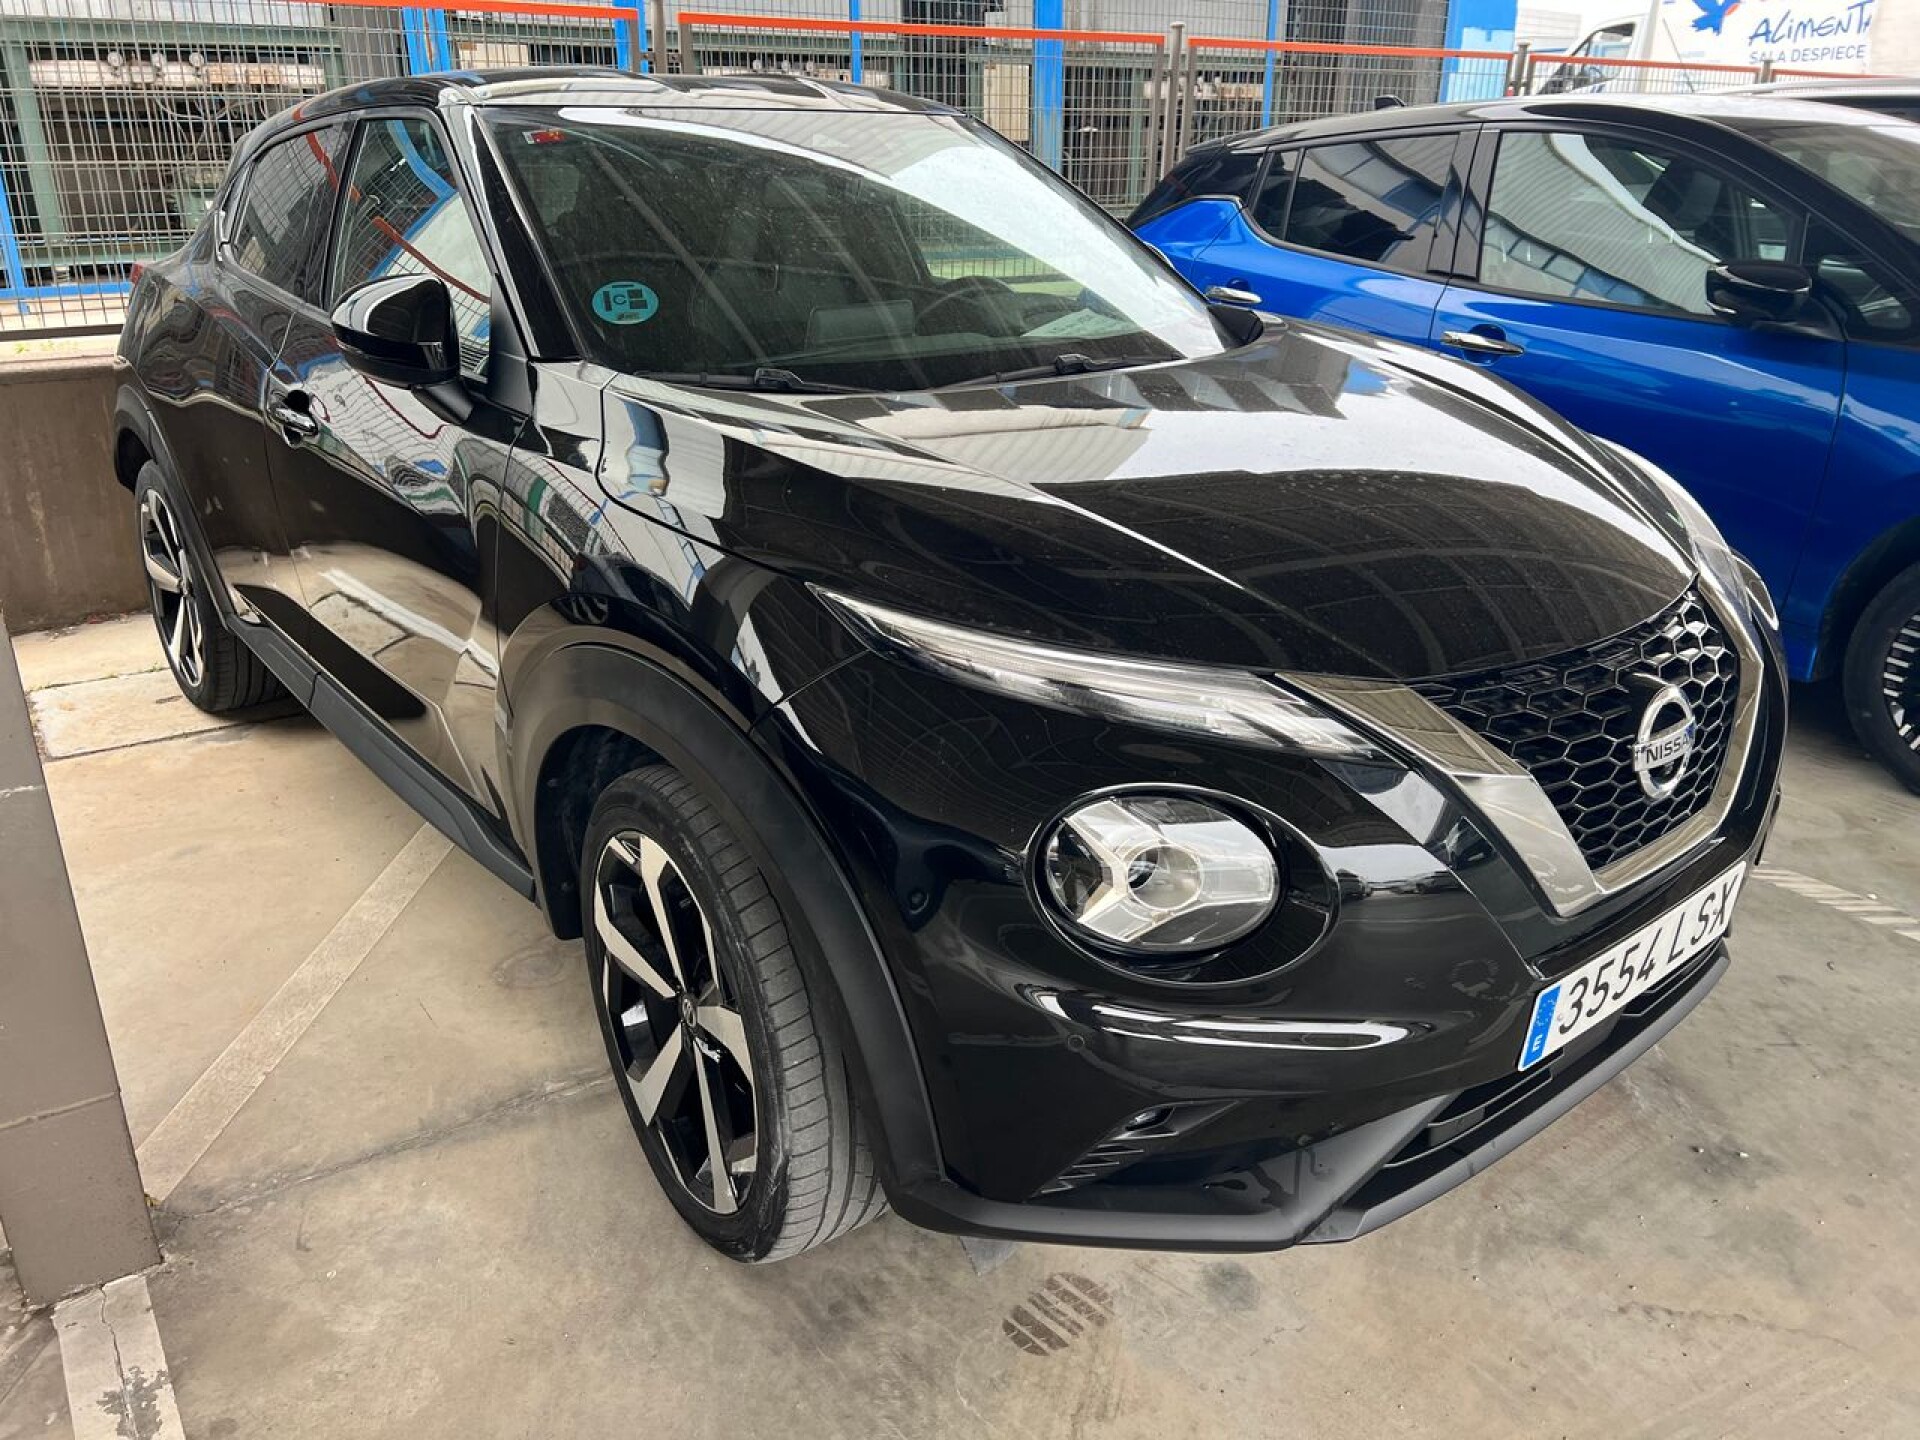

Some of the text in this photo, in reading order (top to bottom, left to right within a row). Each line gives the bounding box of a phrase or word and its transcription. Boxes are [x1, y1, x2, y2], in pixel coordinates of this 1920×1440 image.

[1791, 45, 1867, 62] DESPIECE
[1646, 732, 1692, 763] NISSA
[1559, 872, 1740, 1035] 3554 LSX
[1533, 1035, 1542, 1051] E
